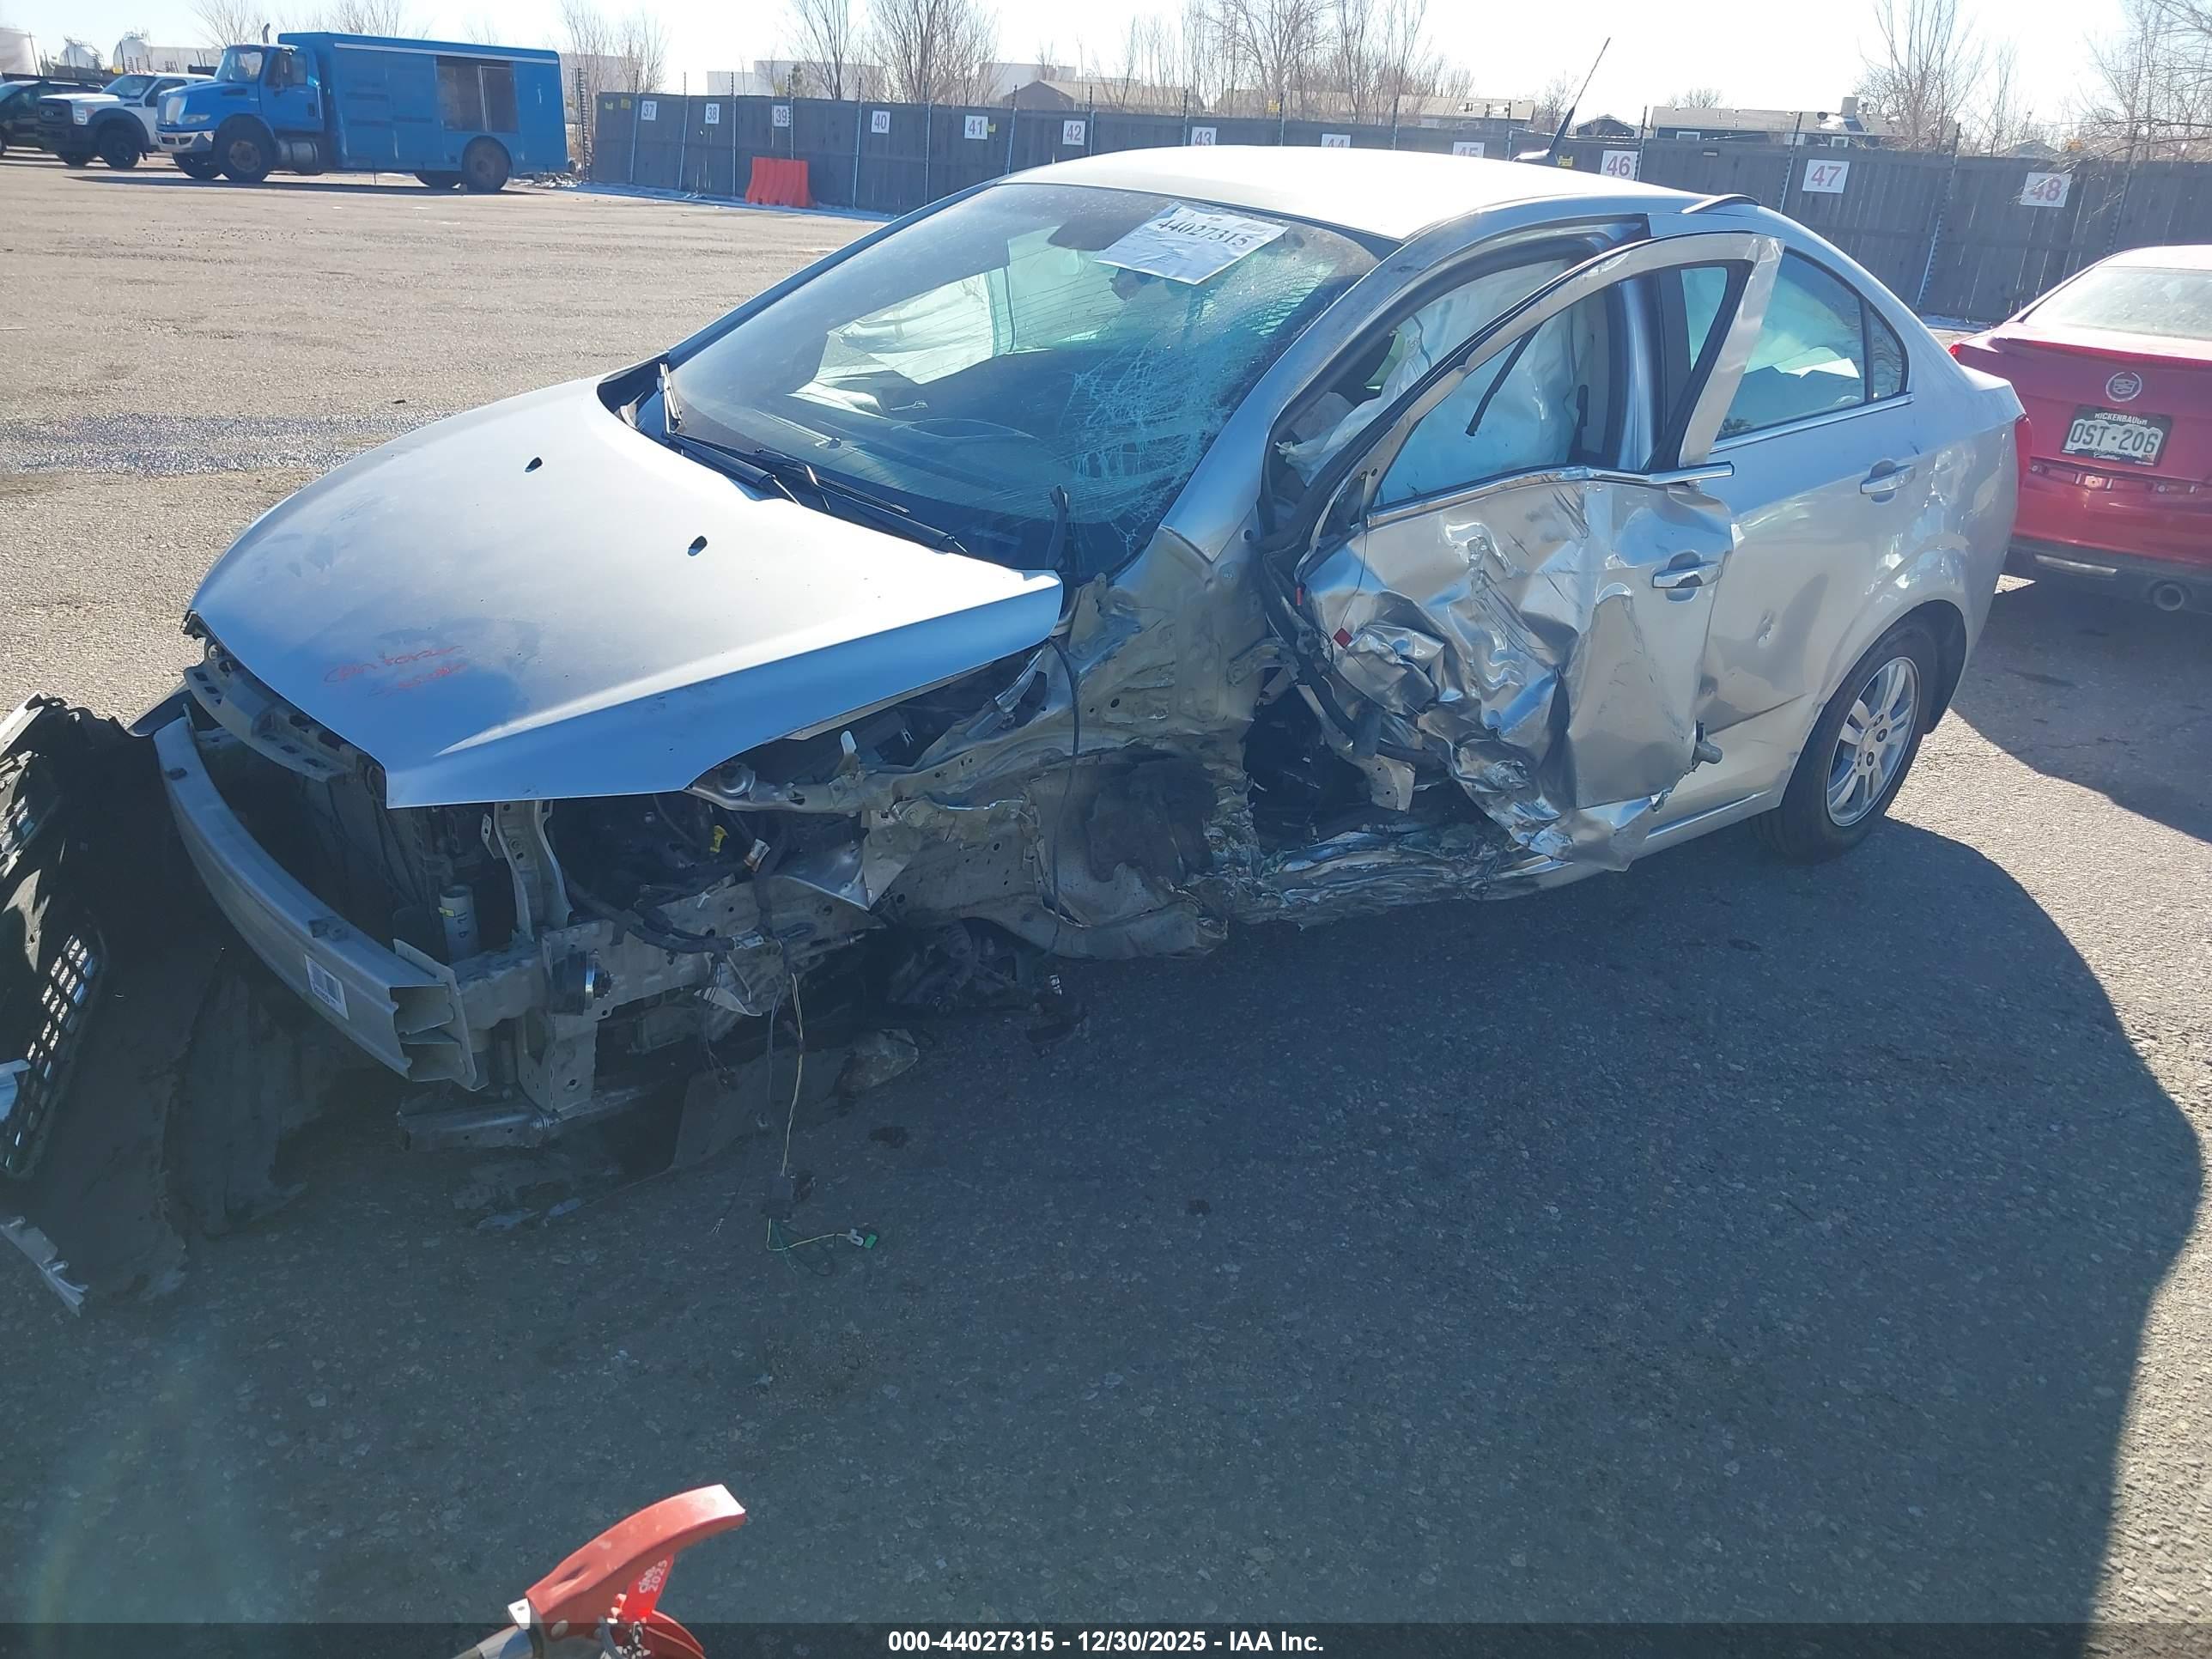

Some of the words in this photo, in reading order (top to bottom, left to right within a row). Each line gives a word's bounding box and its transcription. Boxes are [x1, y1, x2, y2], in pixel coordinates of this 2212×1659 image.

[644, 104, 654, 117] 37
[708, 106, 717, 120] 38
[776, 109, 787, 123] 39
[875, 113, 886, 130] 40
[969, 119, 982, 135] 41
[1066, 125, 1082, 141] 42
[1194, 131, 1212, 146] 43
[1607, 155, 1631, 177] 46
[1811, 165, 1842, 186] 47
[2029, 178, 2062, 202] 48
[1158, 219, 1254, 246] 44027315
